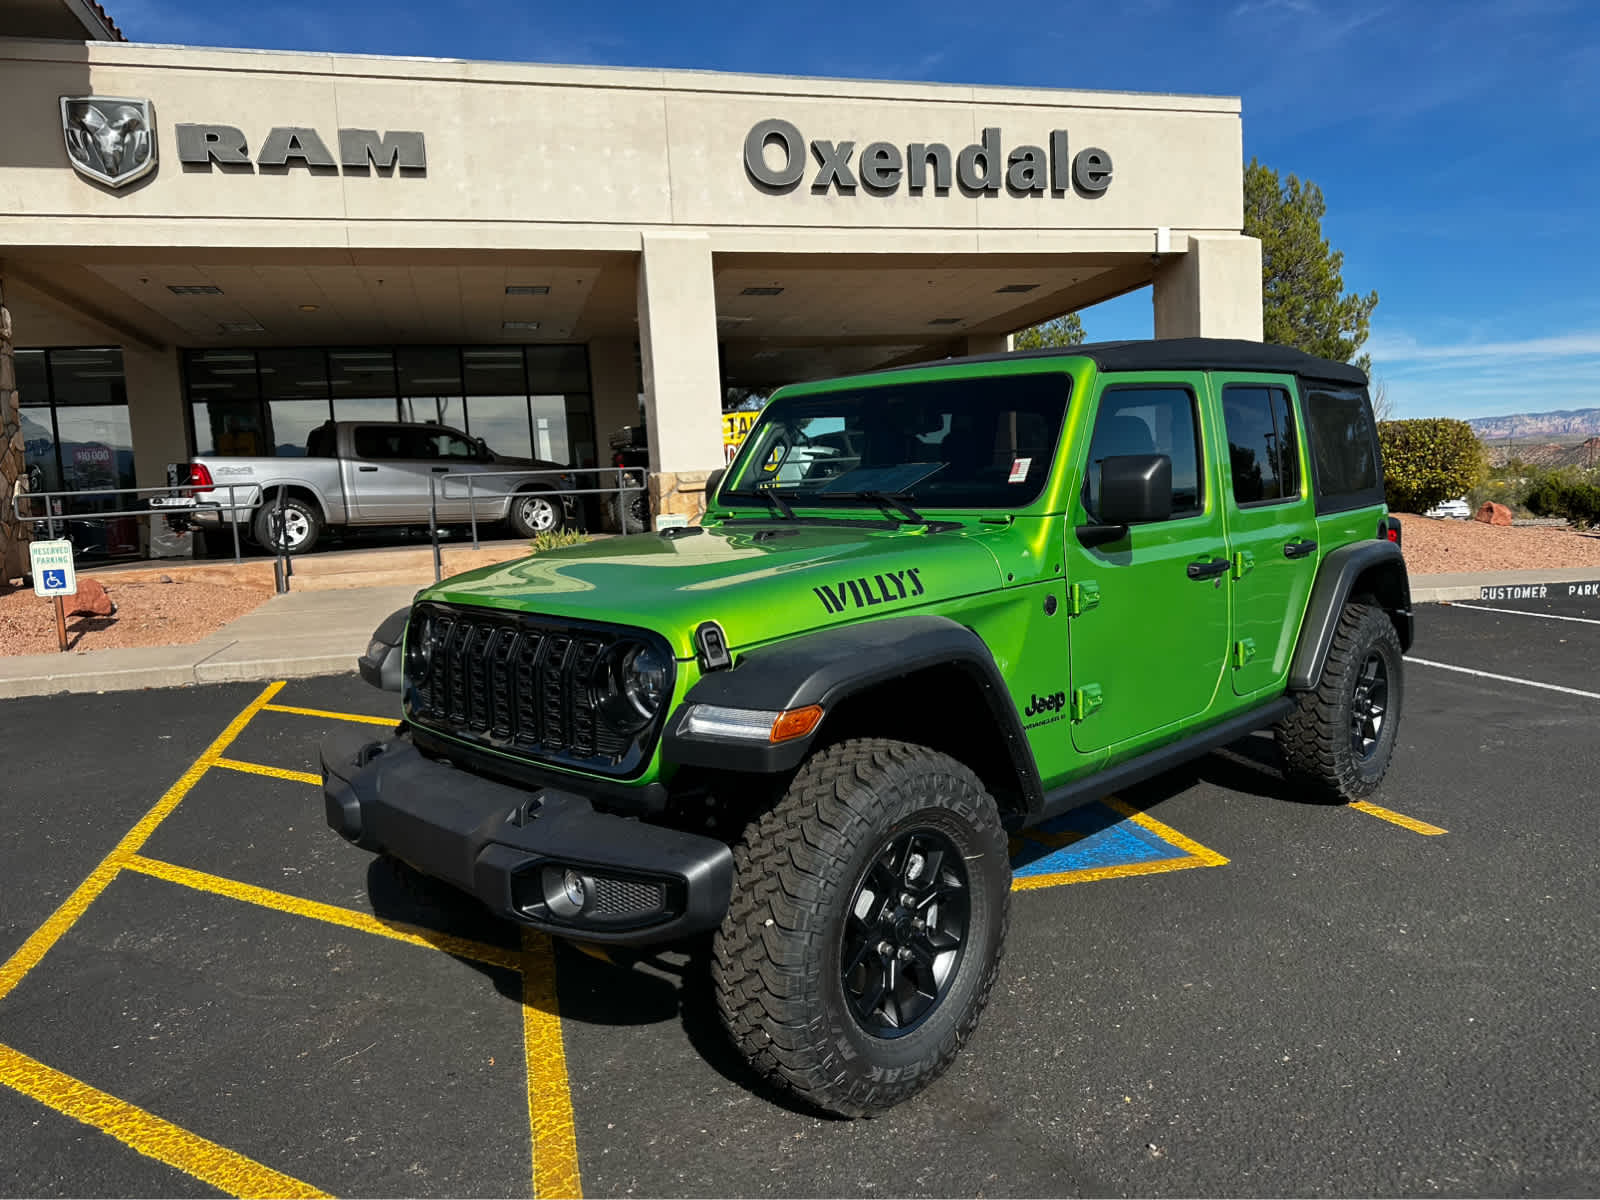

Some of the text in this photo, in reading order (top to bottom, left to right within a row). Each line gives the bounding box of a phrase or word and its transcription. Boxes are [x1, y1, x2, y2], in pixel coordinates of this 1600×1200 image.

[175, 123, 426, 172] RAM
[743, 118, 1113, 197] Oxendale
[32, 546, 69, 555] RESERVED
[36, 556, 69, 564] PARKING
[812, 567, 925, 614] WILLYS
[1480, 584, 1600, 600] CUSTOMER PARK
[1025, 691, 1065, 717] Jeep
